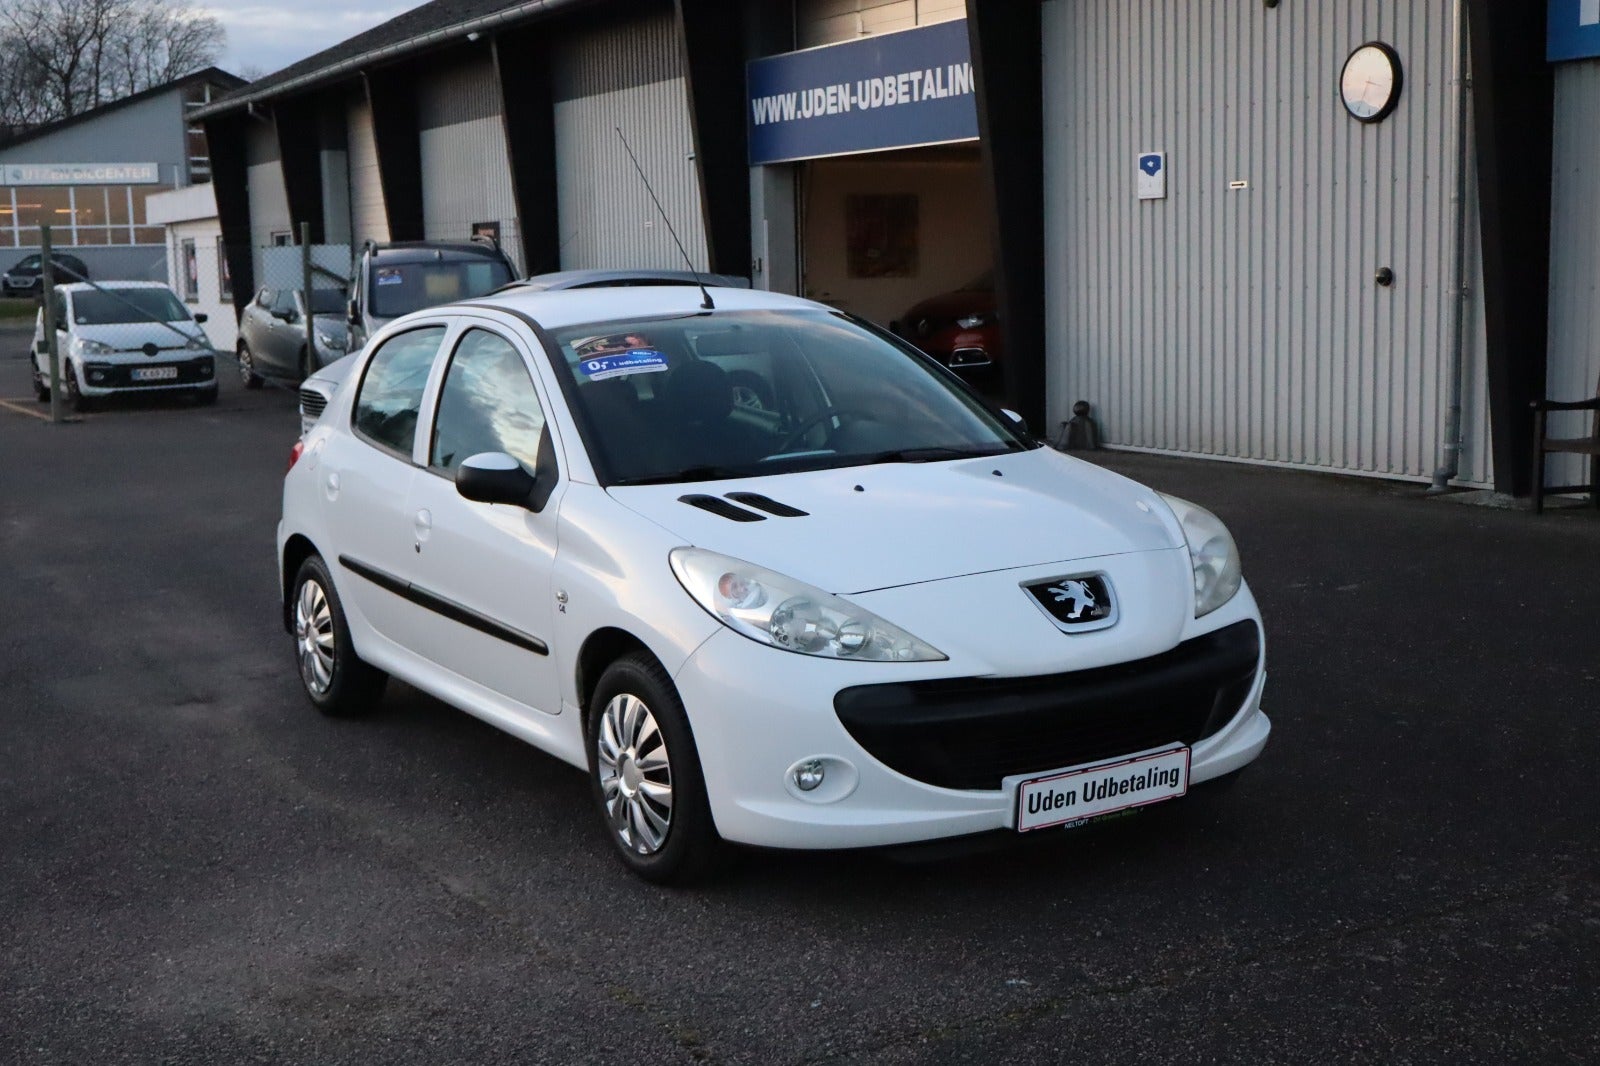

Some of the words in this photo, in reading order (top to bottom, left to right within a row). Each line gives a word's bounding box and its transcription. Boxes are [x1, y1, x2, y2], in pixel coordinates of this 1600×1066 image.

[618, 357, 663, 367] udbetaling
[1028, 789, 1077, 815] Uden
[1082, 766, 1180, 803] Udbetaling
